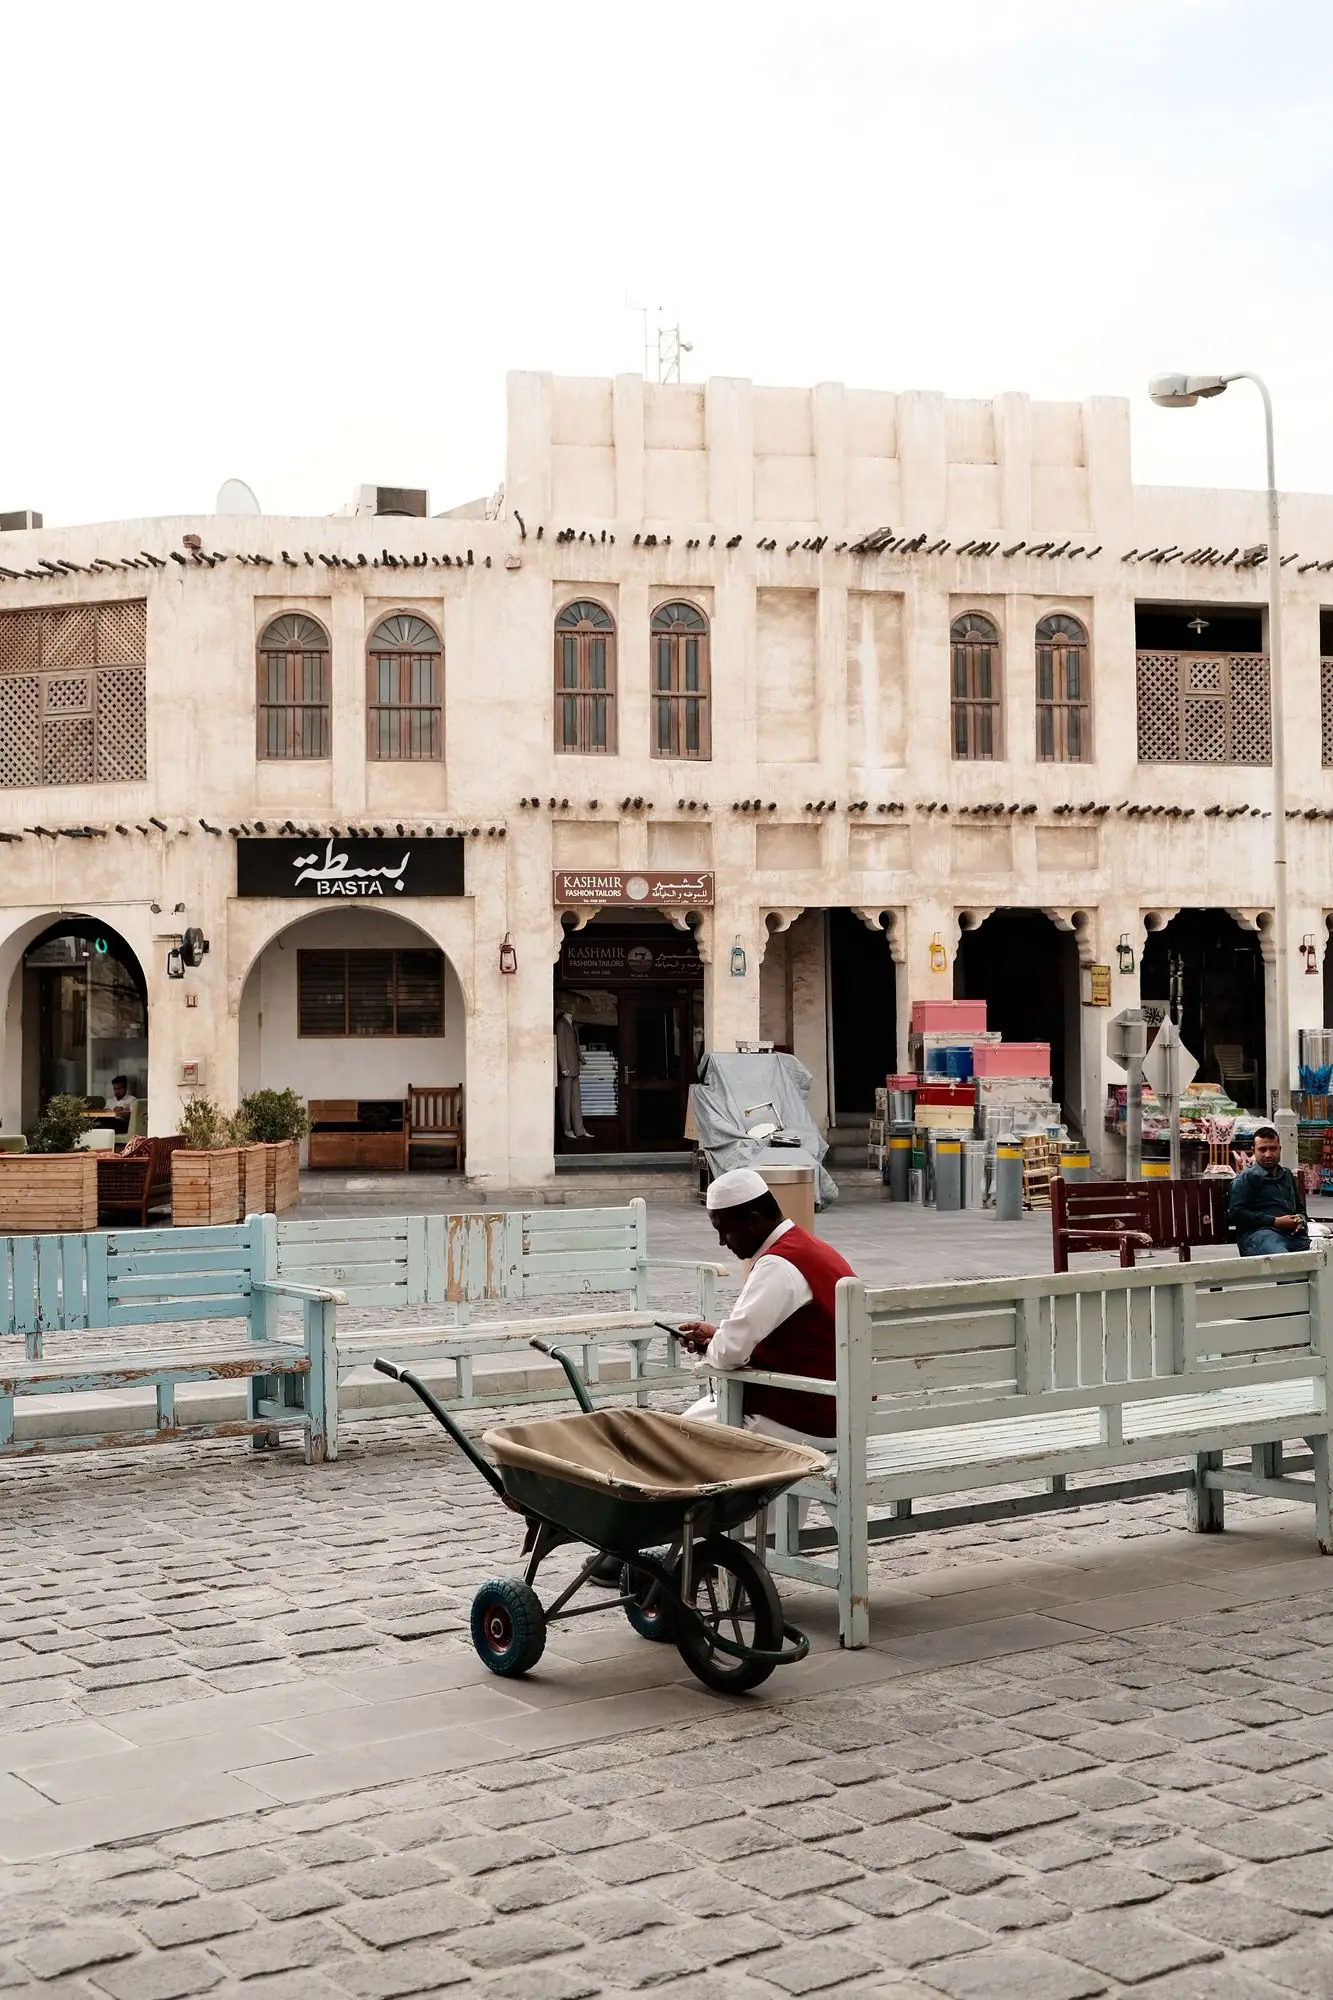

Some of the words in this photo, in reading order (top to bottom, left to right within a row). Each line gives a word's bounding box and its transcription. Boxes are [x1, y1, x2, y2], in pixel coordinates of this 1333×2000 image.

[292, 838, 411, 892] بسطة
[317, 881, 384, 895] BASTA
[564, 876, 623, 888] KASHMIR
[652, 874, 708, 890] كشمير
[567, 948, 625, 958] KASHMIR
[656, 948, 699, 960] شمير
